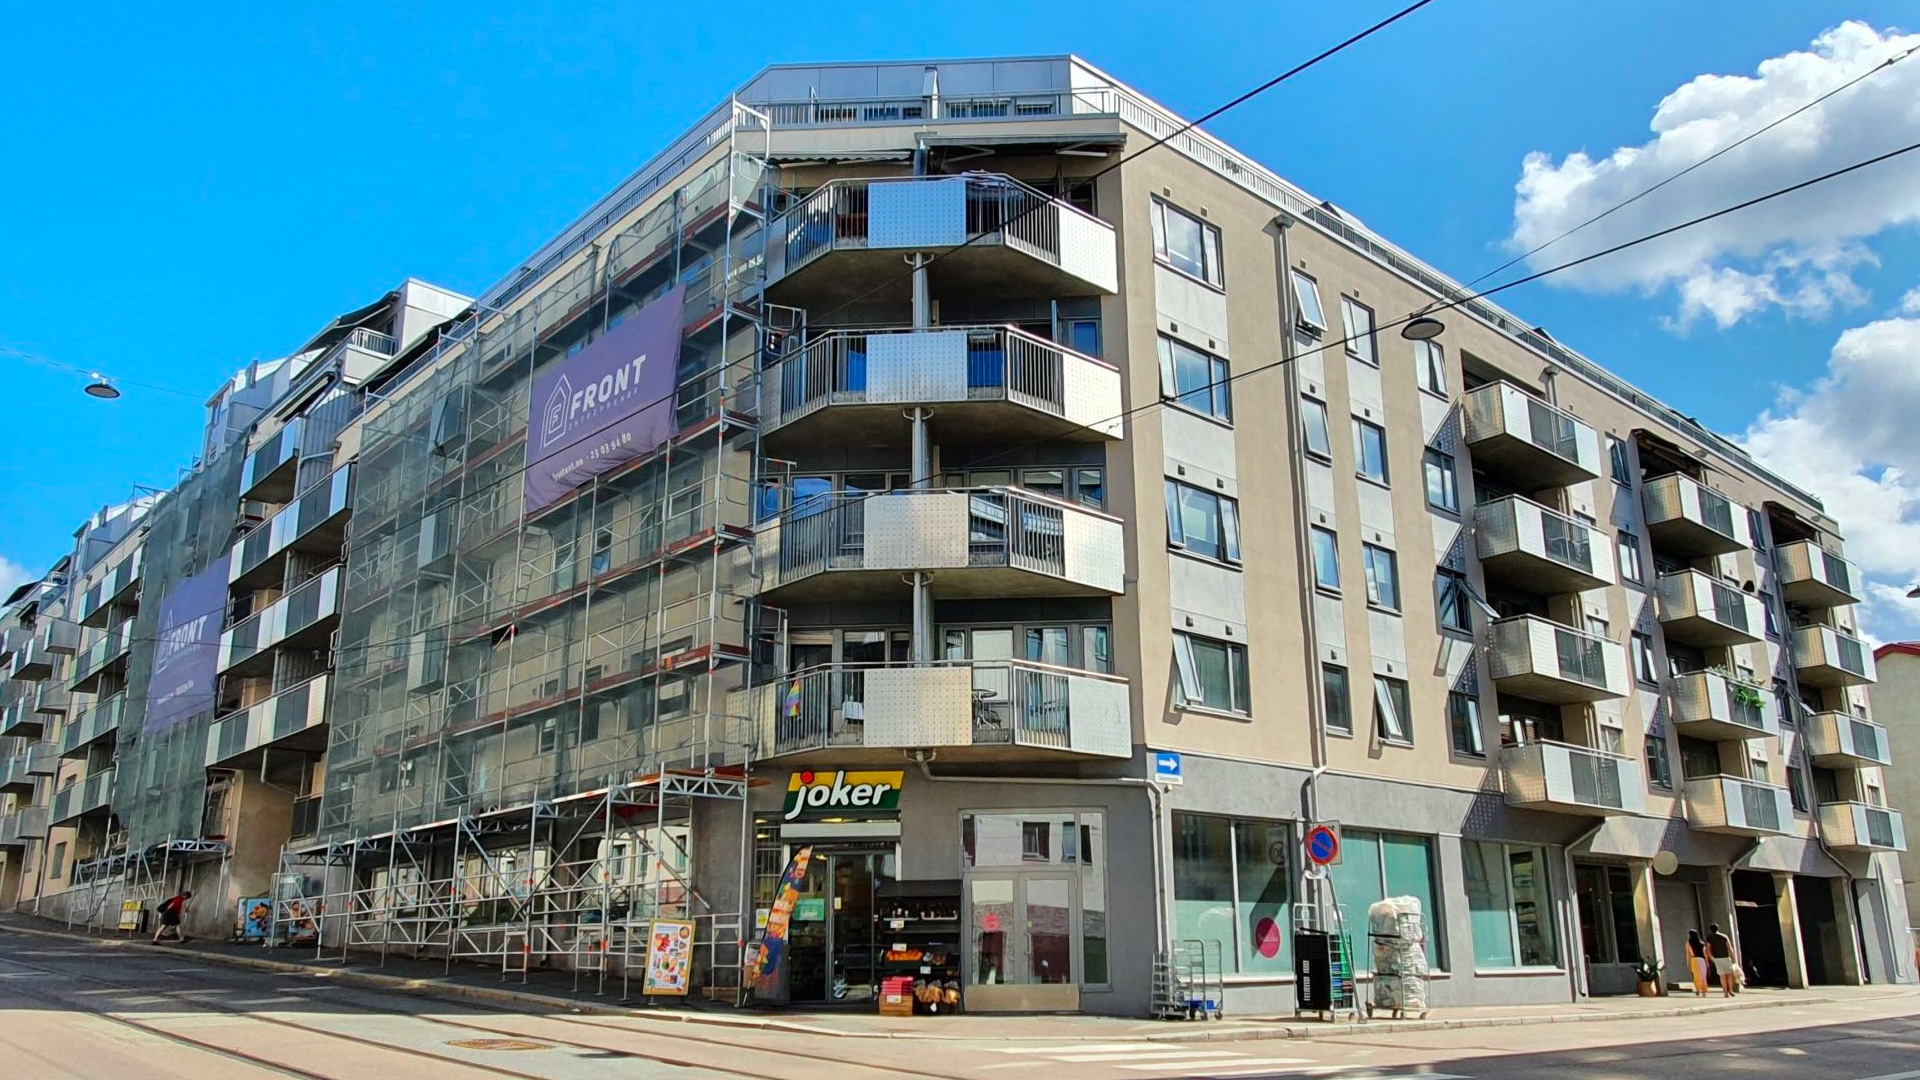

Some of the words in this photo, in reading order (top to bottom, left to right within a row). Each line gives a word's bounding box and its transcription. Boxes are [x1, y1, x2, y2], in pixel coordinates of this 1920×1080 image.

[570, 354, 647, 420] FRONT
[168, 614, 208, 655] FRONT
[784, 770, 891, 820] joker
